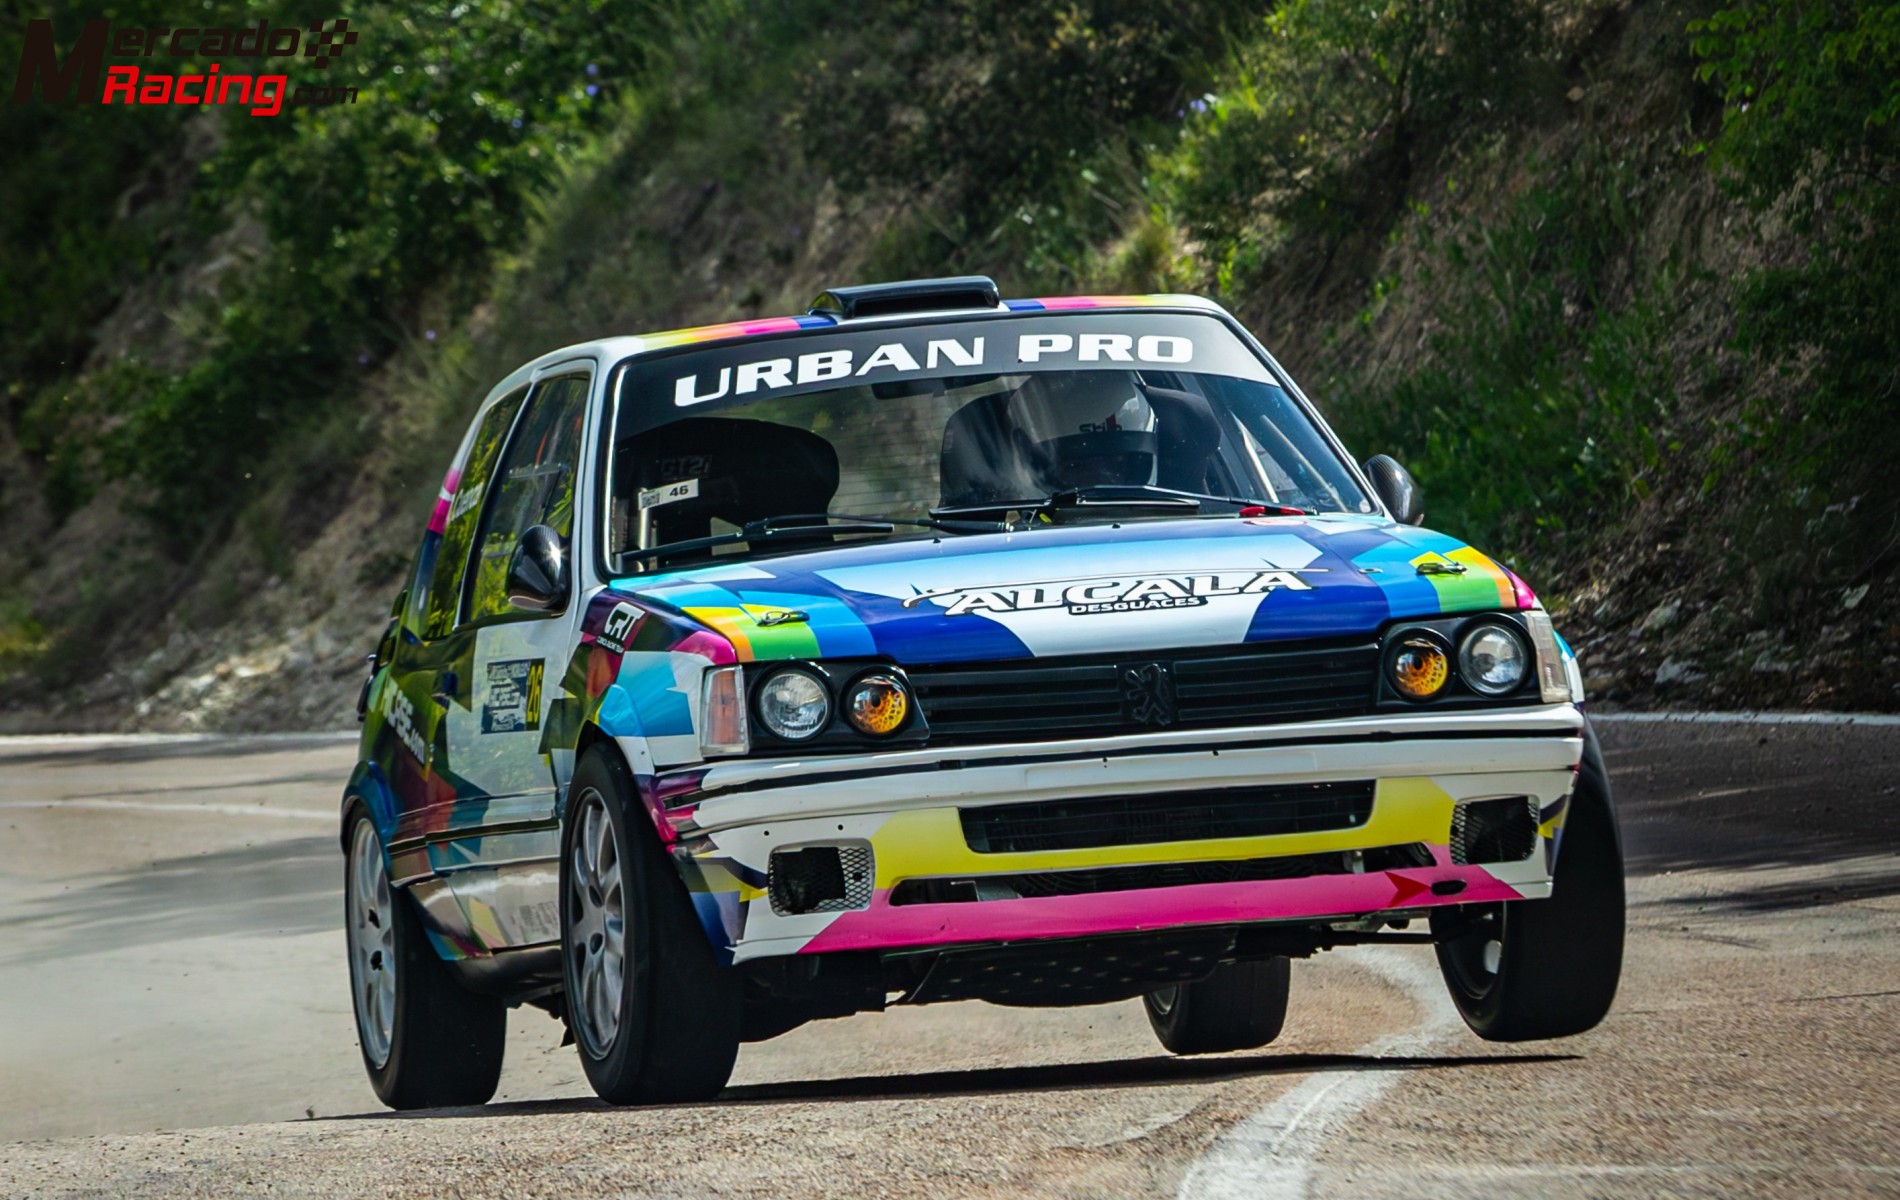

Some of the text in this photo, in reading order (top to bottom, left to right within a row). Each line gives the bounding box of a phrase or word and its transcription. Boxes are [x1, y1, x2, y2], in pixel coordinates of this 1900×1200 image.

[674, 333, 1194, 407] URBAN PRO
[669, 485, 689, 497] 46
[944, 570, 1318, 616] ALCALA
[1069, 597, 1202, 615] DESGUACES
[527, 664, 543, 723] 26
